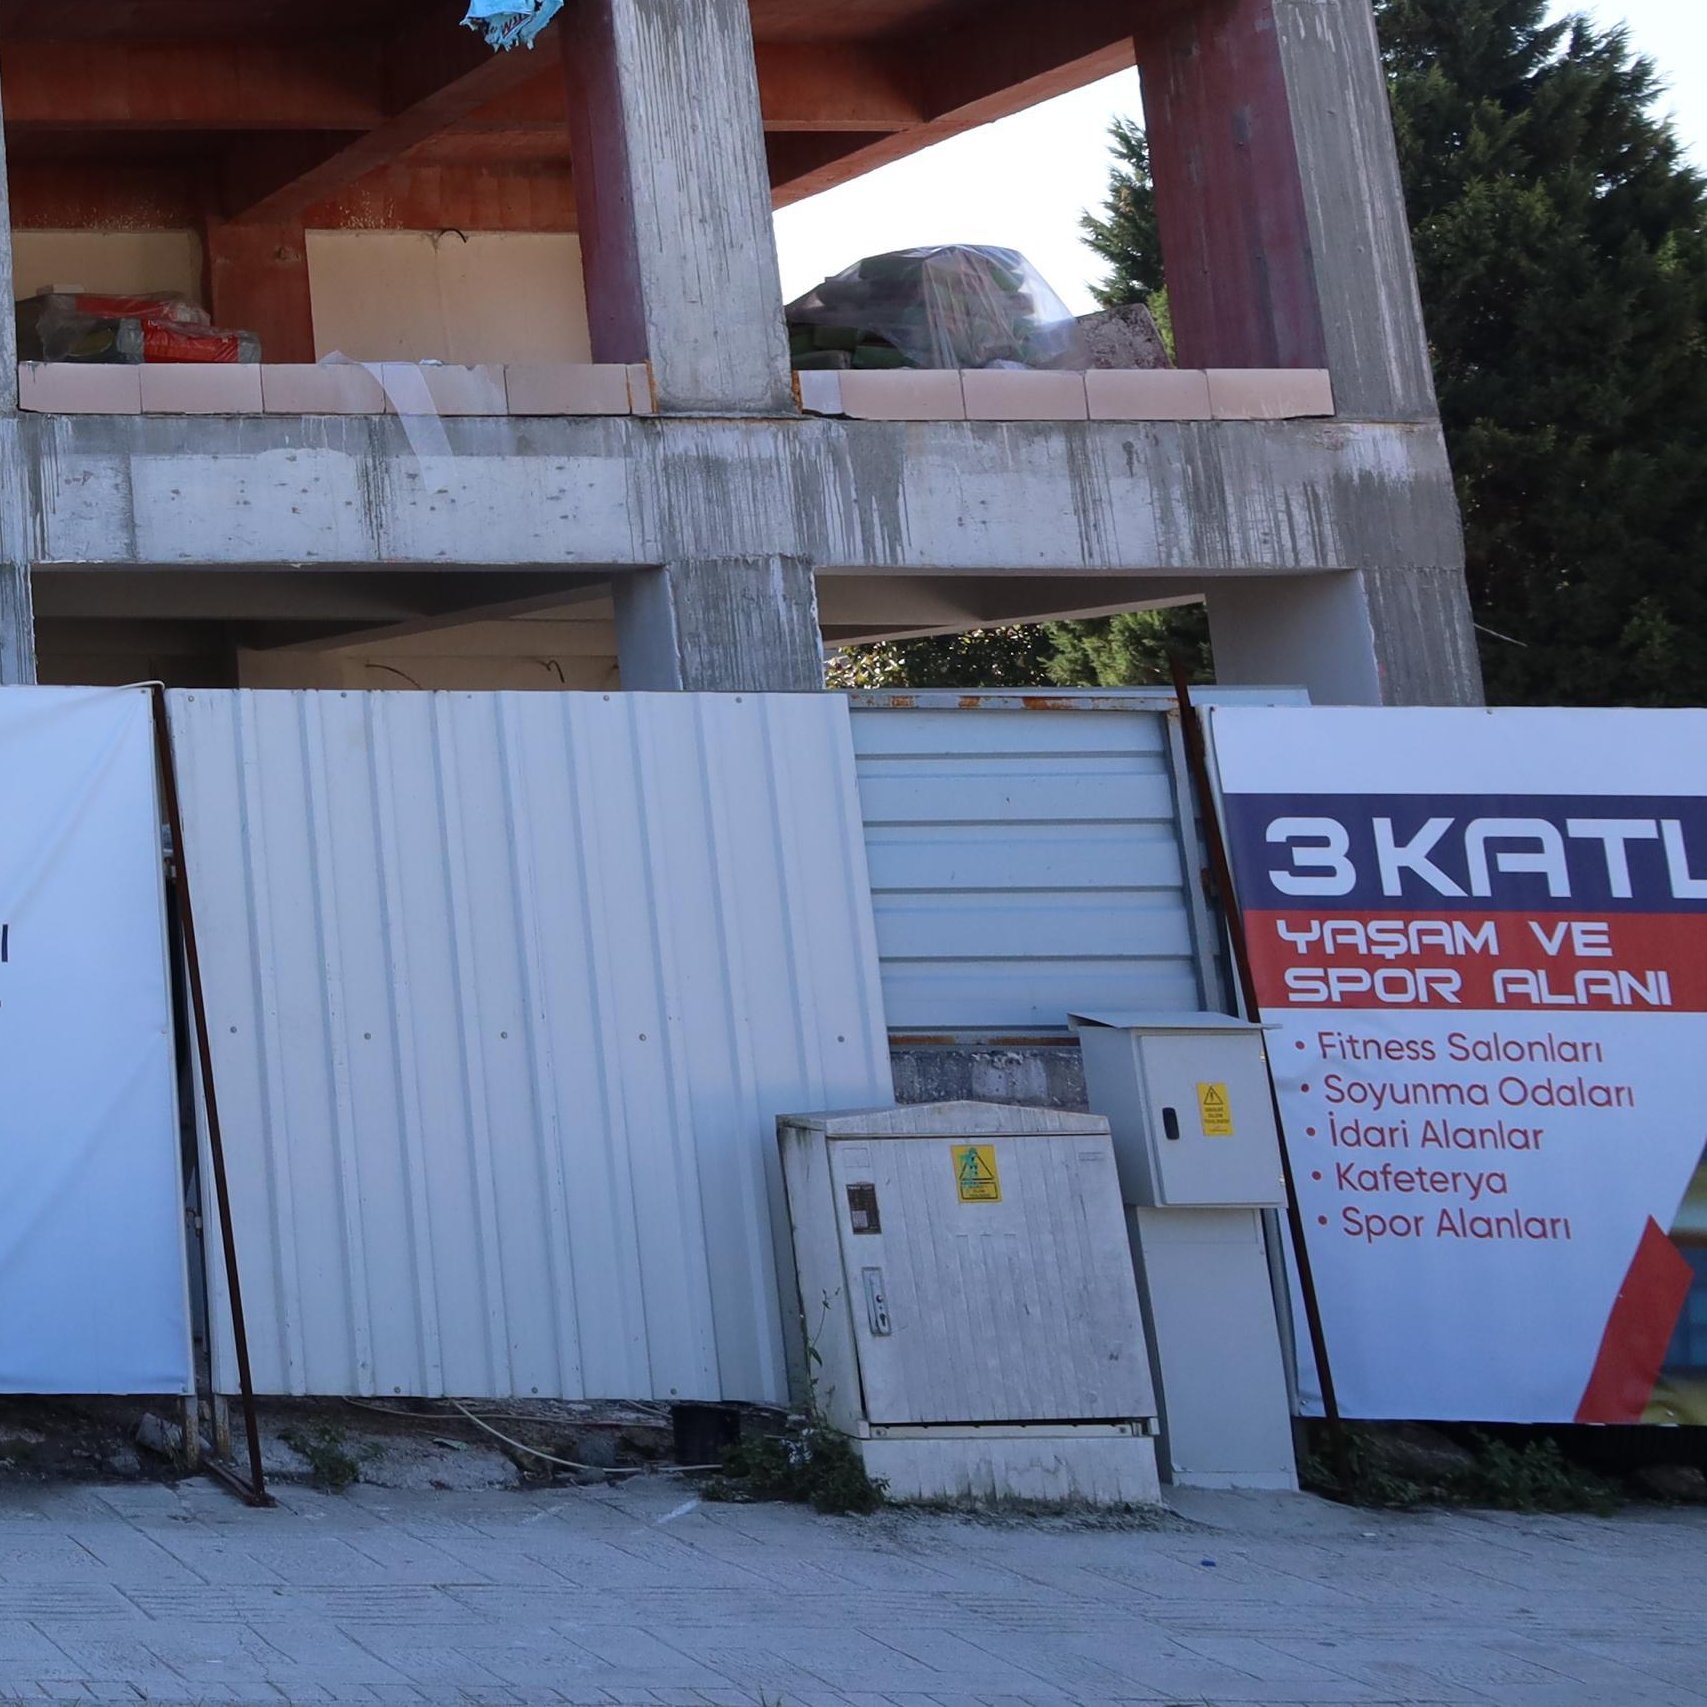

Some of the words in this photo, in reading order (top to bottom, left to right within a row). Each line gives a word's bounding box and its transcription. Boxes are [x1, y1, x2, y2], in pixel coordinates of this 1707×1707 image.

[1266, 817, 1356, 895] 3
[1277, 920, 1499, 959] YAŞAM
[1529, 922, 1612, 956] VE
[1285, 968, 1461, 1003] SPOR
[1493, 969, 1671, 1005] ALANI
[1319, 1032, 1435, 1060] Fitness
[1448, 1033, 1602, 1062] Salonları
[1325, 1074, 1488, 1110] Soyunma
[1499, 1077, 1633, 1107] Odaları
[1329, 1112, 1408, 1147] İdari
[1422, 1120, 1543, 1149] Alanlar
[1336, 1163, 1507, 1200] Kafeterya
[1343, 1207, 1423, 1243] Spor
[1437, 1208, 1570, 1239] Alanları
